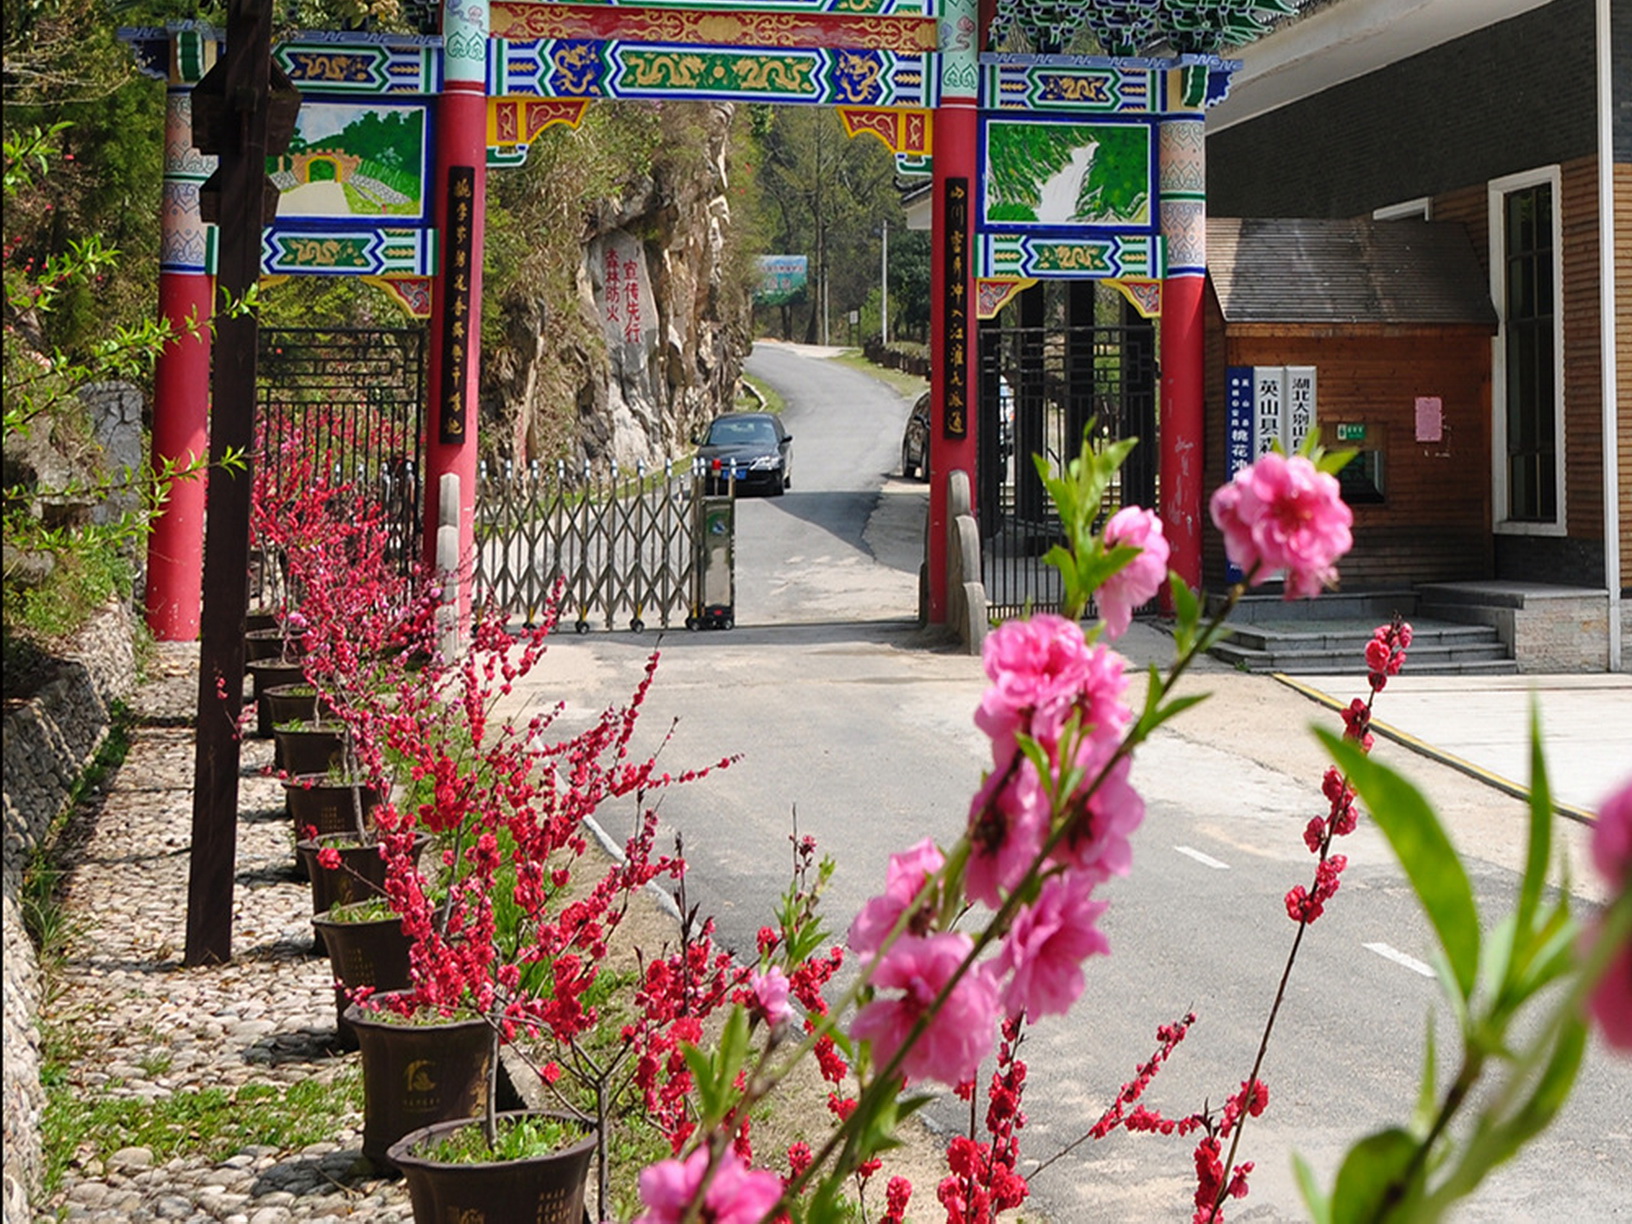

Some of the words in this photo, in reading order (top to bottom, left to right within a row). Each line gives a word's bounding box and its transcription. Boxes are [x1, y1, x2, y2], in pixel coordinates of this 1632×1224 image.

[605, 247, 620, 323] 森林防火
[623, 258, 641, 344] 宣传先行
